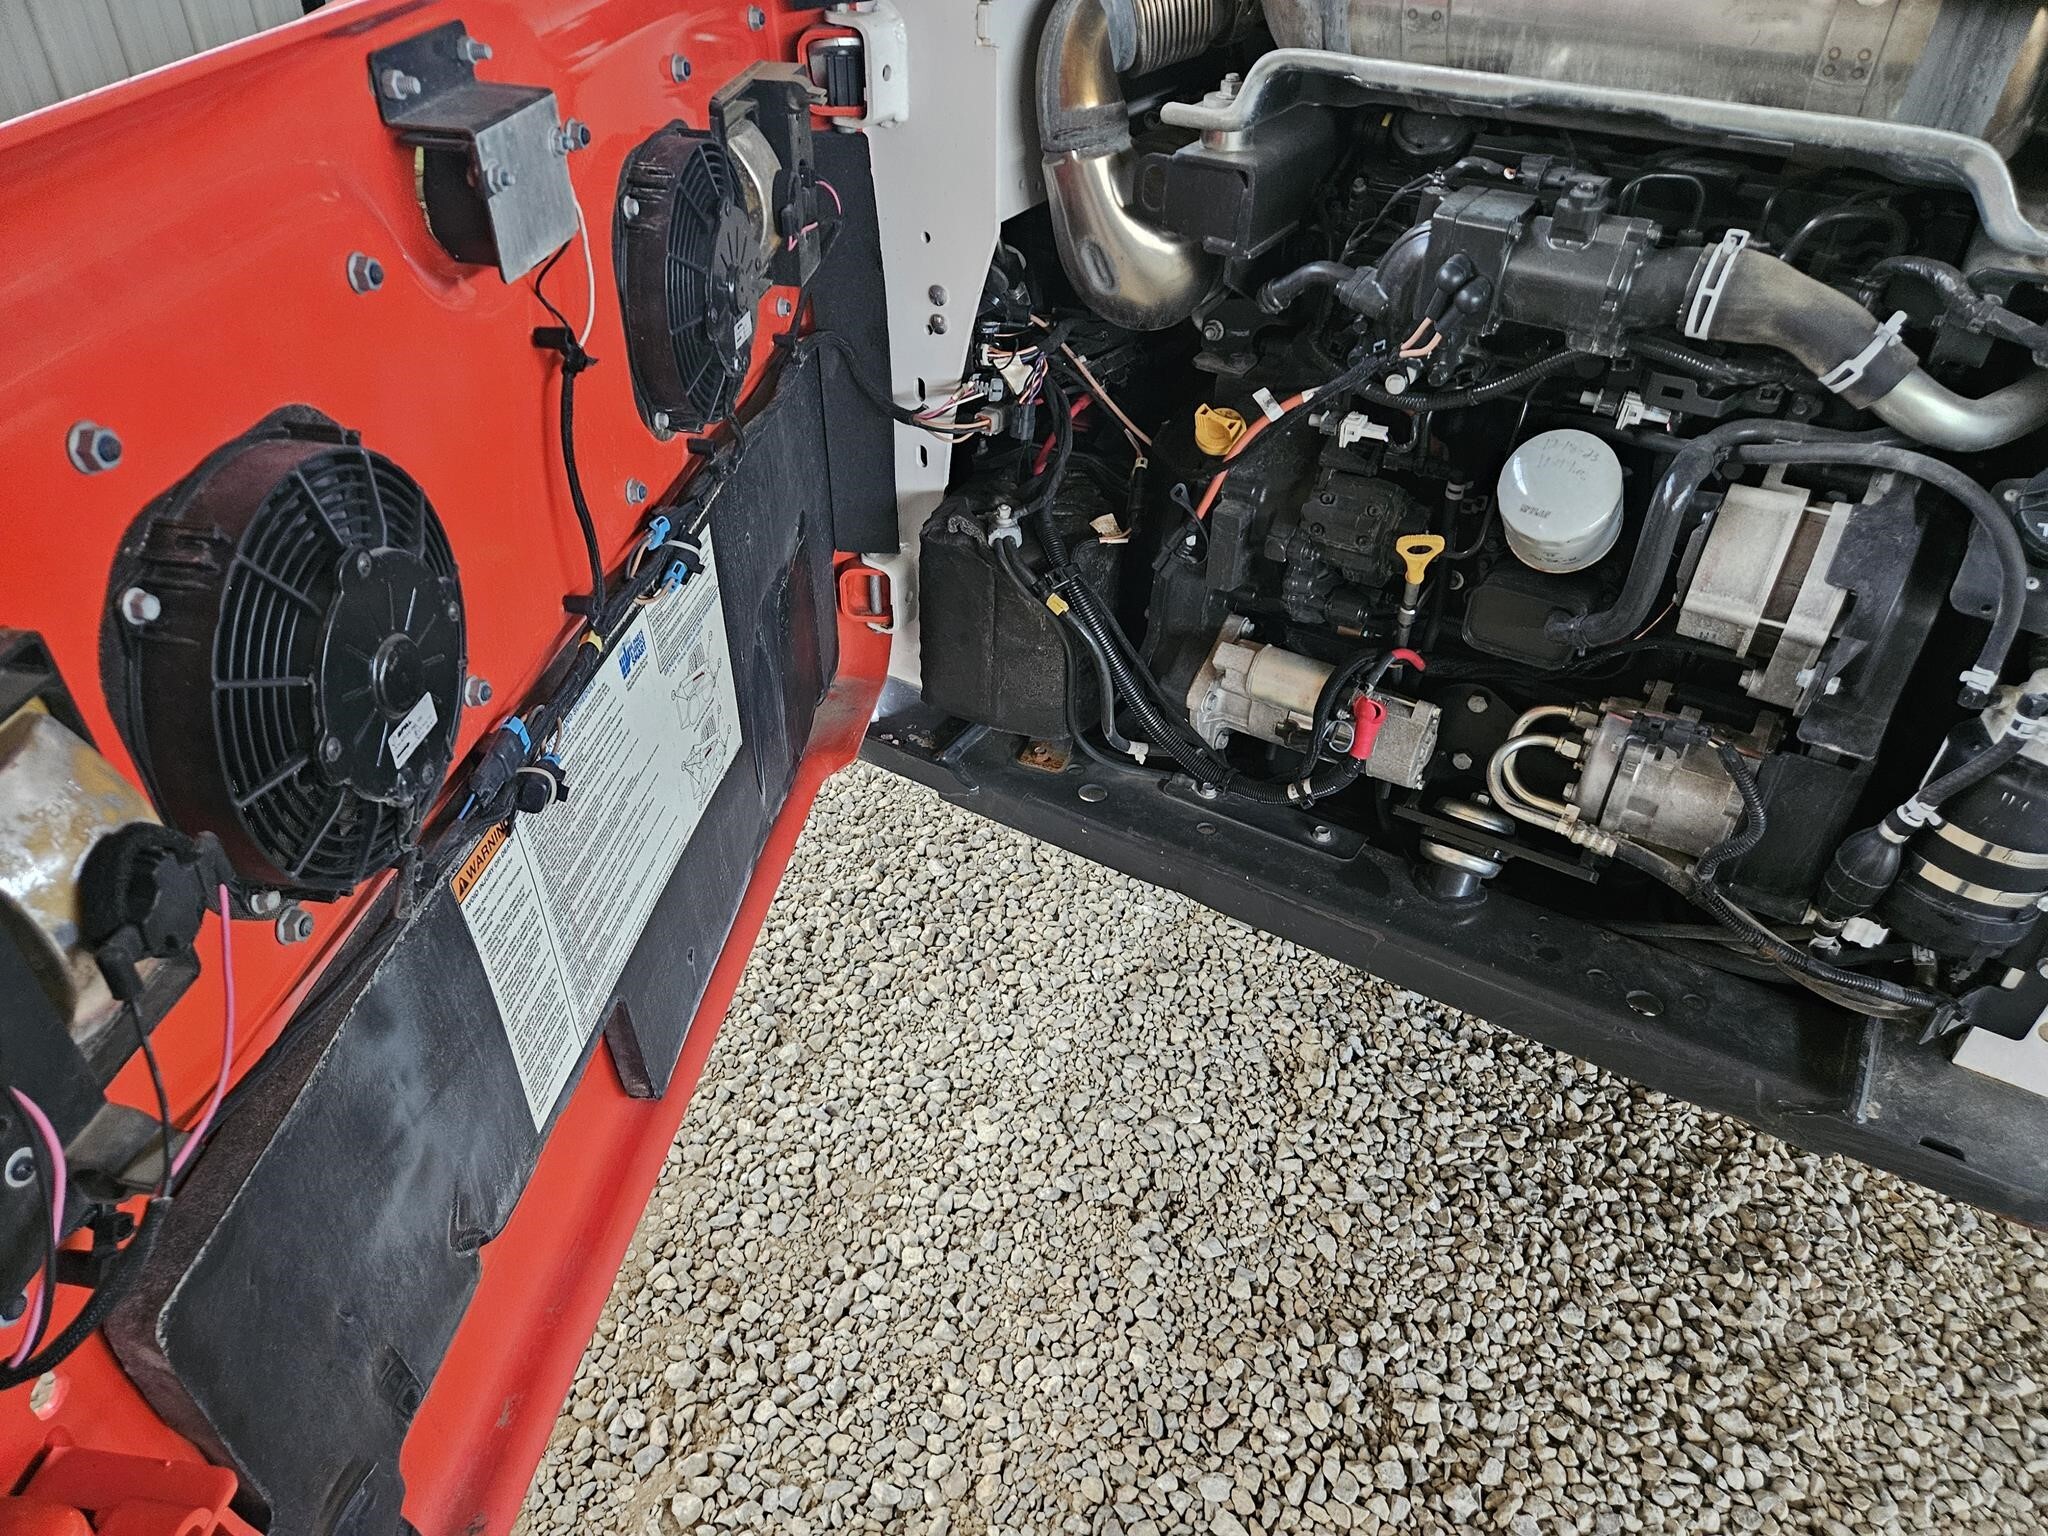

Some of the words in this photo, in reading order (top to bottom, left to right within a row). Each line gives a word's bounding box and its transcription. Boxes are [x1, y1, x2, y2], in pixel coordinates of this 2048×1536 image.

[631, 641, 646, 666] SMART
[571, 679, 595, 715] SCHEDULE
[464, 887, 479, 911] AVOID
[478, 864, 494, 891] INJURY
[493, 854, 501, 869] OR
[500, 834, 514, 858] DEATH
